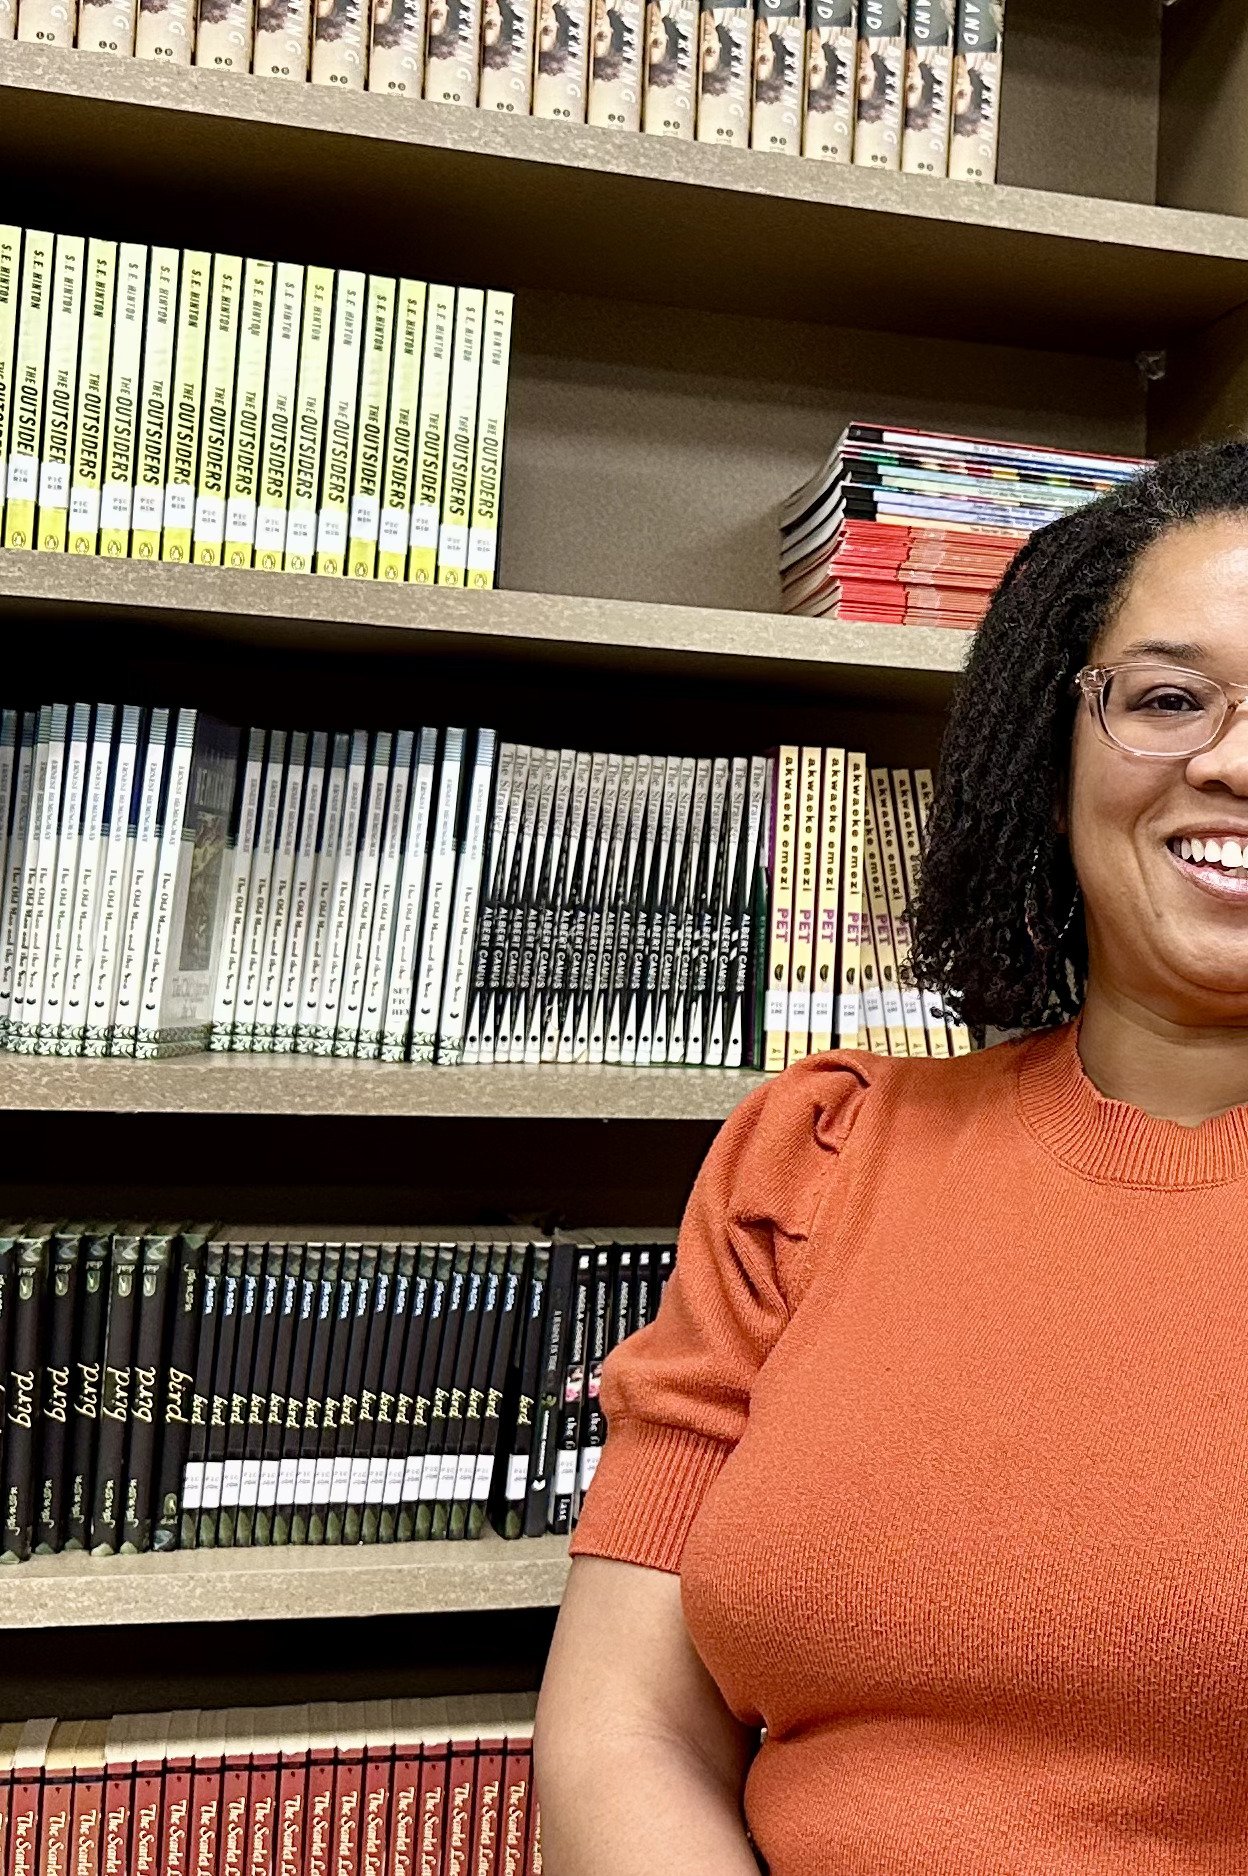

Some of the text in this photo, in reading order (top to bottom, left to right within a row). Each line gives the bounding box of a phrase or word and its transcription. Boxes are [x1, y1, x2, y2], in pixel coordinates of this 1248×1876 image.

[675, 9, 694, 111] BURNING
[729, 18, 748, 119] BURNING
[782, 27, 801, 127] BURNING
[833, 36, 853, 135] BURNING
[883, 46, 902, 145] BURNING
[930, 55, 949, 152] BURNING
[978, 63, 998, 159] BURNING
[94, 281, 106, 317] HINTON
[188, 291, 200, 328] HINTON
[219, 294, 231, 332] HINTON
[404, 320, 417, 355] HINTON
[79, 374, 101, 480] THE OUTSIDERS
[111, 376, 133, 482] THE OUTSIDERS
[174, 383, 195, 485] THE OUTSIDERS
[205, 387, 226, 492] THE OUTSIDERS
[236, 392, 257, 495] THE OUTSIDERS
[296, 397, 317, 499] THE OUTSIDERS
[390, 409, 410, 510] THE OUTSIDERS
[449, 416, 469, 516] THE OUTSIDERS
[478, 418, 499, 519] THE OUTSIDERS
[501, 752, 513, 777] The
[516, 753, 528, 777] The
[561, 758, 573, 781] The
[715, 764, 727, 788] The
[780, 757, 794, 891] akwaeke emezi
[803, 758, 816, 892] akwaeke emezi
[826, 758, 840, 891] akwaeke emezi
[850, 763, 861, 895] akwaeke emezi
[877, 779, 902, 900] akwaeke emezi
[476, 907, 493, 988] ALBERT CAMUS
[490, 907, 508, 988] ALBERT CAMUS
[537, 909, 554, 989] ALBERT CAMUS
[697, 913, 712, 991] ALBERT CAMUS
[776, 908, 789, 943] PET
[799, 910, 811, 944] PET
[822, 909, 835, 943] PET
[847, 913, 860, 947] PET
[876, 914, 891, 946] PET
[8, 1371, 34, 1429] bird
[44, 1366, 69, 1423] bird
[74, 1363, 99, 1420] bird
[103, 1366, 130, 1423] bird
[131, 1366, 156, 1424] bird
[165, 1367, 193, 1424] bird
[191, 1393, 208, 1425] bird
[268, 1392, 286, 1424] bird
[323, 1397, 341, 1428] bird
[395, 1393, 414, 1424] bird
[432, 1387, 449, 1419] bird
[485, 1387, 503, 1418] bird
[517, 1394, 534, 1425] bird
[171, 1799, 187, 1825] The
[314, 1791, 330, 1816] The
[368, 1788, 385, 1813] The
[454, 1782, 470, 1807] The
[508, 1781, 526, 1805] The
